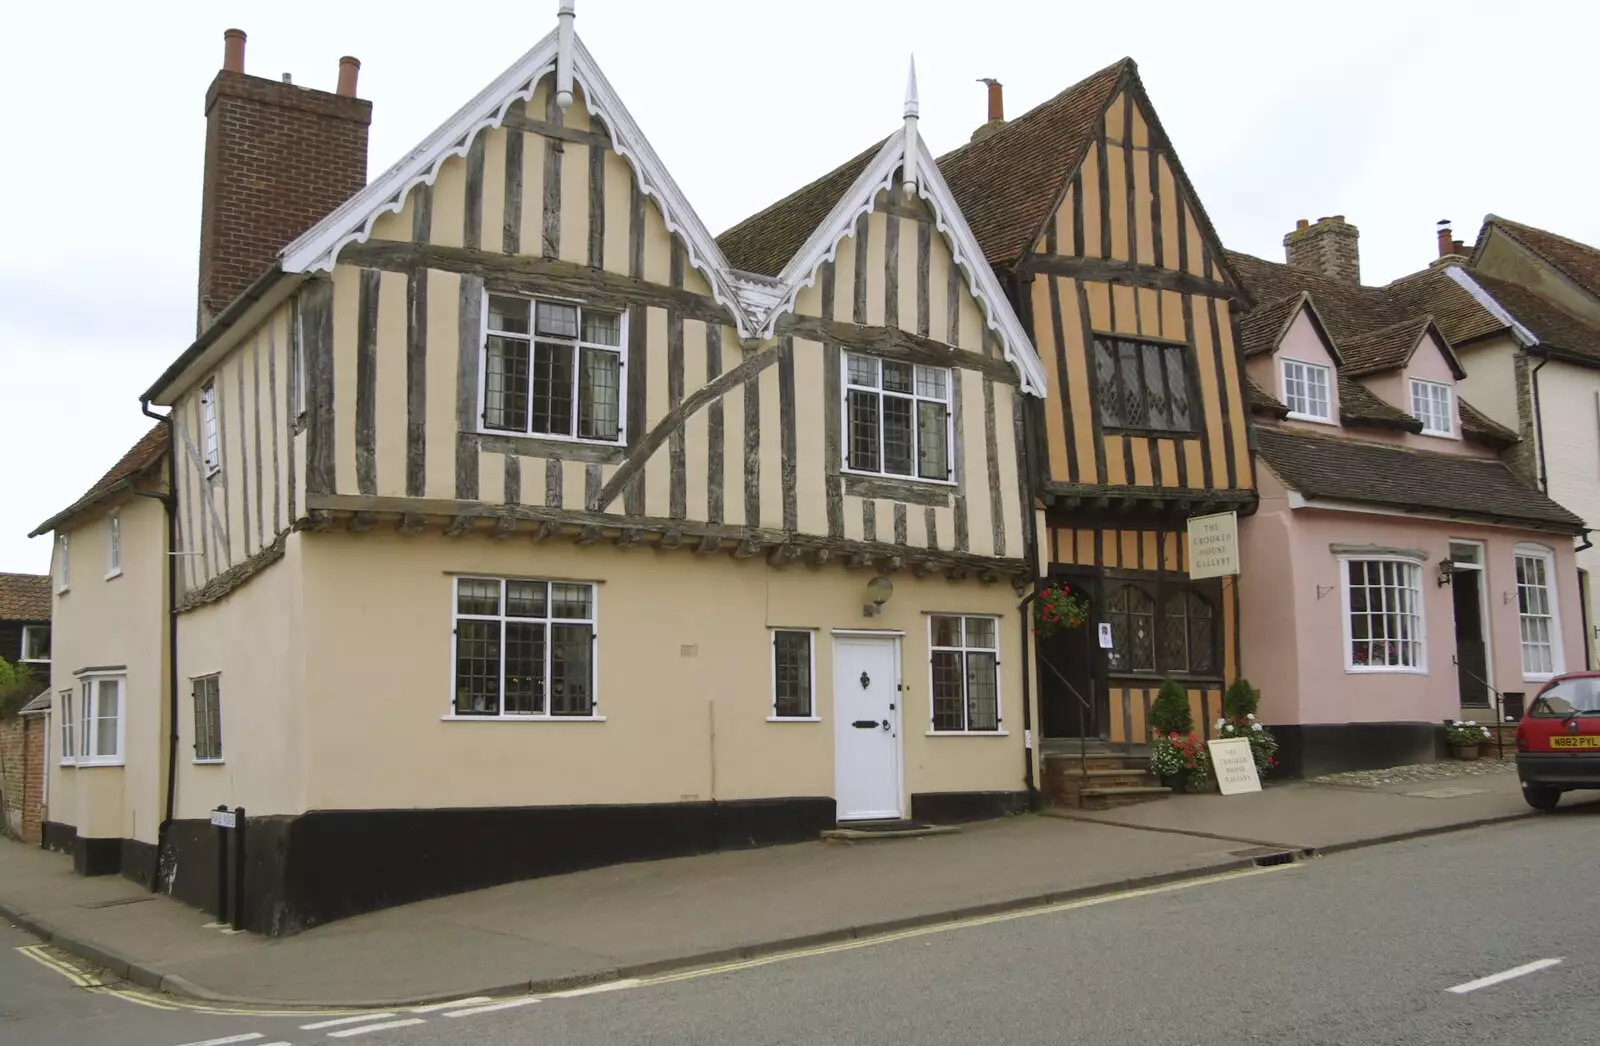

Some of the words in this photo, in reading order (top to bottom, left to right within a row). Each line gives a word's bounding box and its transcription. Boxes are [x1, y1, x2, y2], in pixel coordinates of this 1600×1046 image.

[1204, 523, 1219, 533] THE
[1193, 533, 1232, 545] CROOKED
[1199, 546, 1227, 556] HOUSE
[1196, 557, 1231, 568] GALLERY
[1554, 737, 1578, 747] N882
[1580, 737, 1598, 747] PYL
